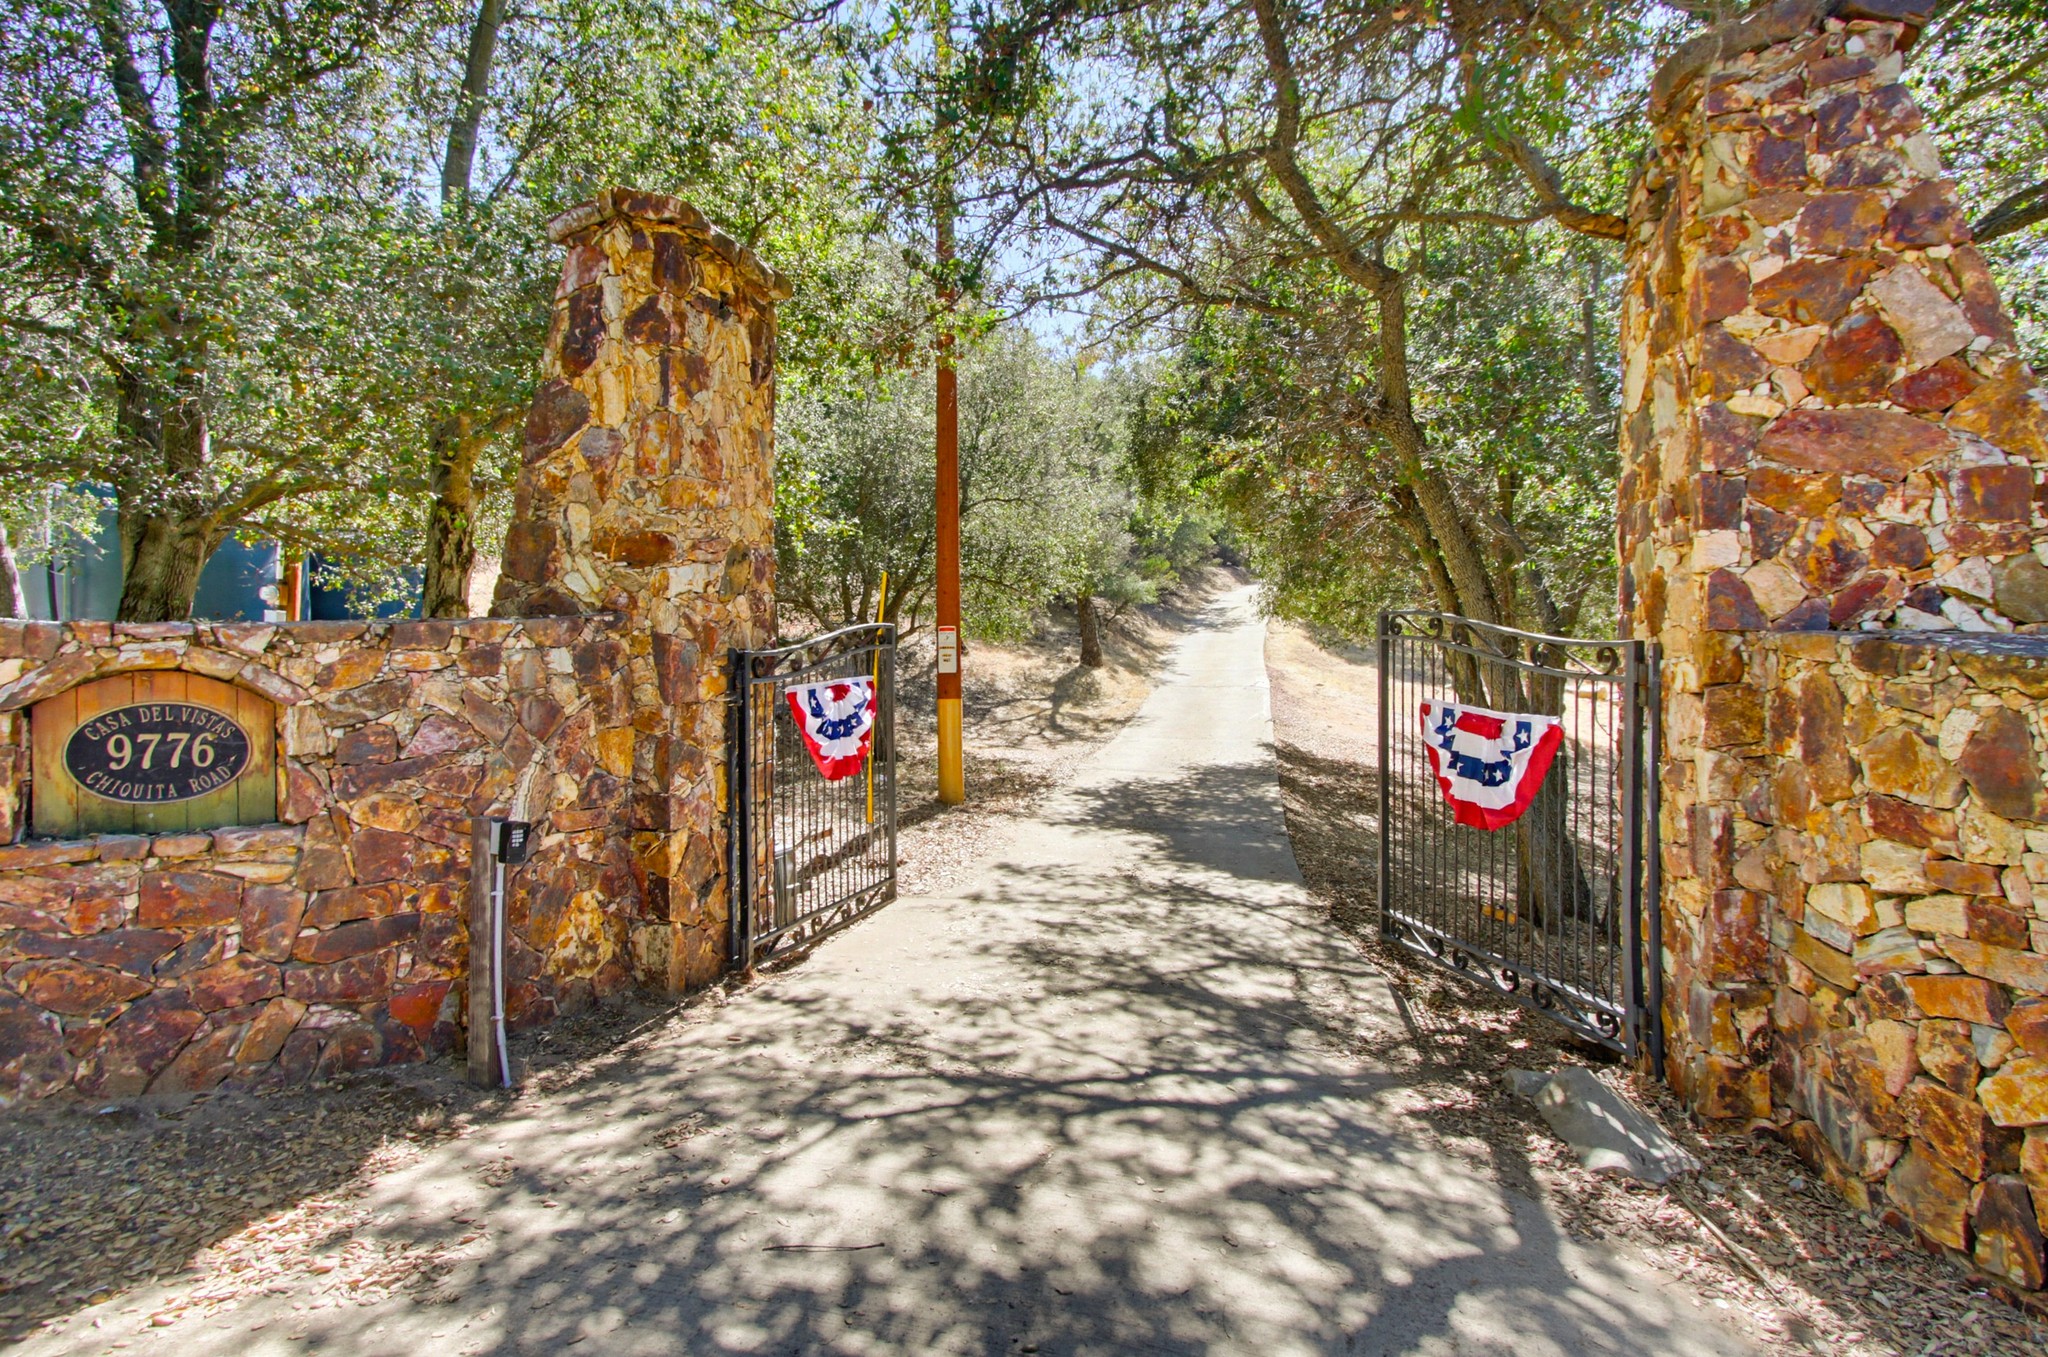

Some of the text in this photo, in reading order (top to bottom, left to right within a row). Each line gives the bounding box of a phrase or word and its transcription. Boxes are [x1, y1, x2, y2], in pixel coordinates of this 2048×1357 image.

[84, 706, 236, 741] CASA DEL VISTAS
[106, 733, 217, 771] 9776
[86, 766, 231, 800] CHIQUITA ROAD
